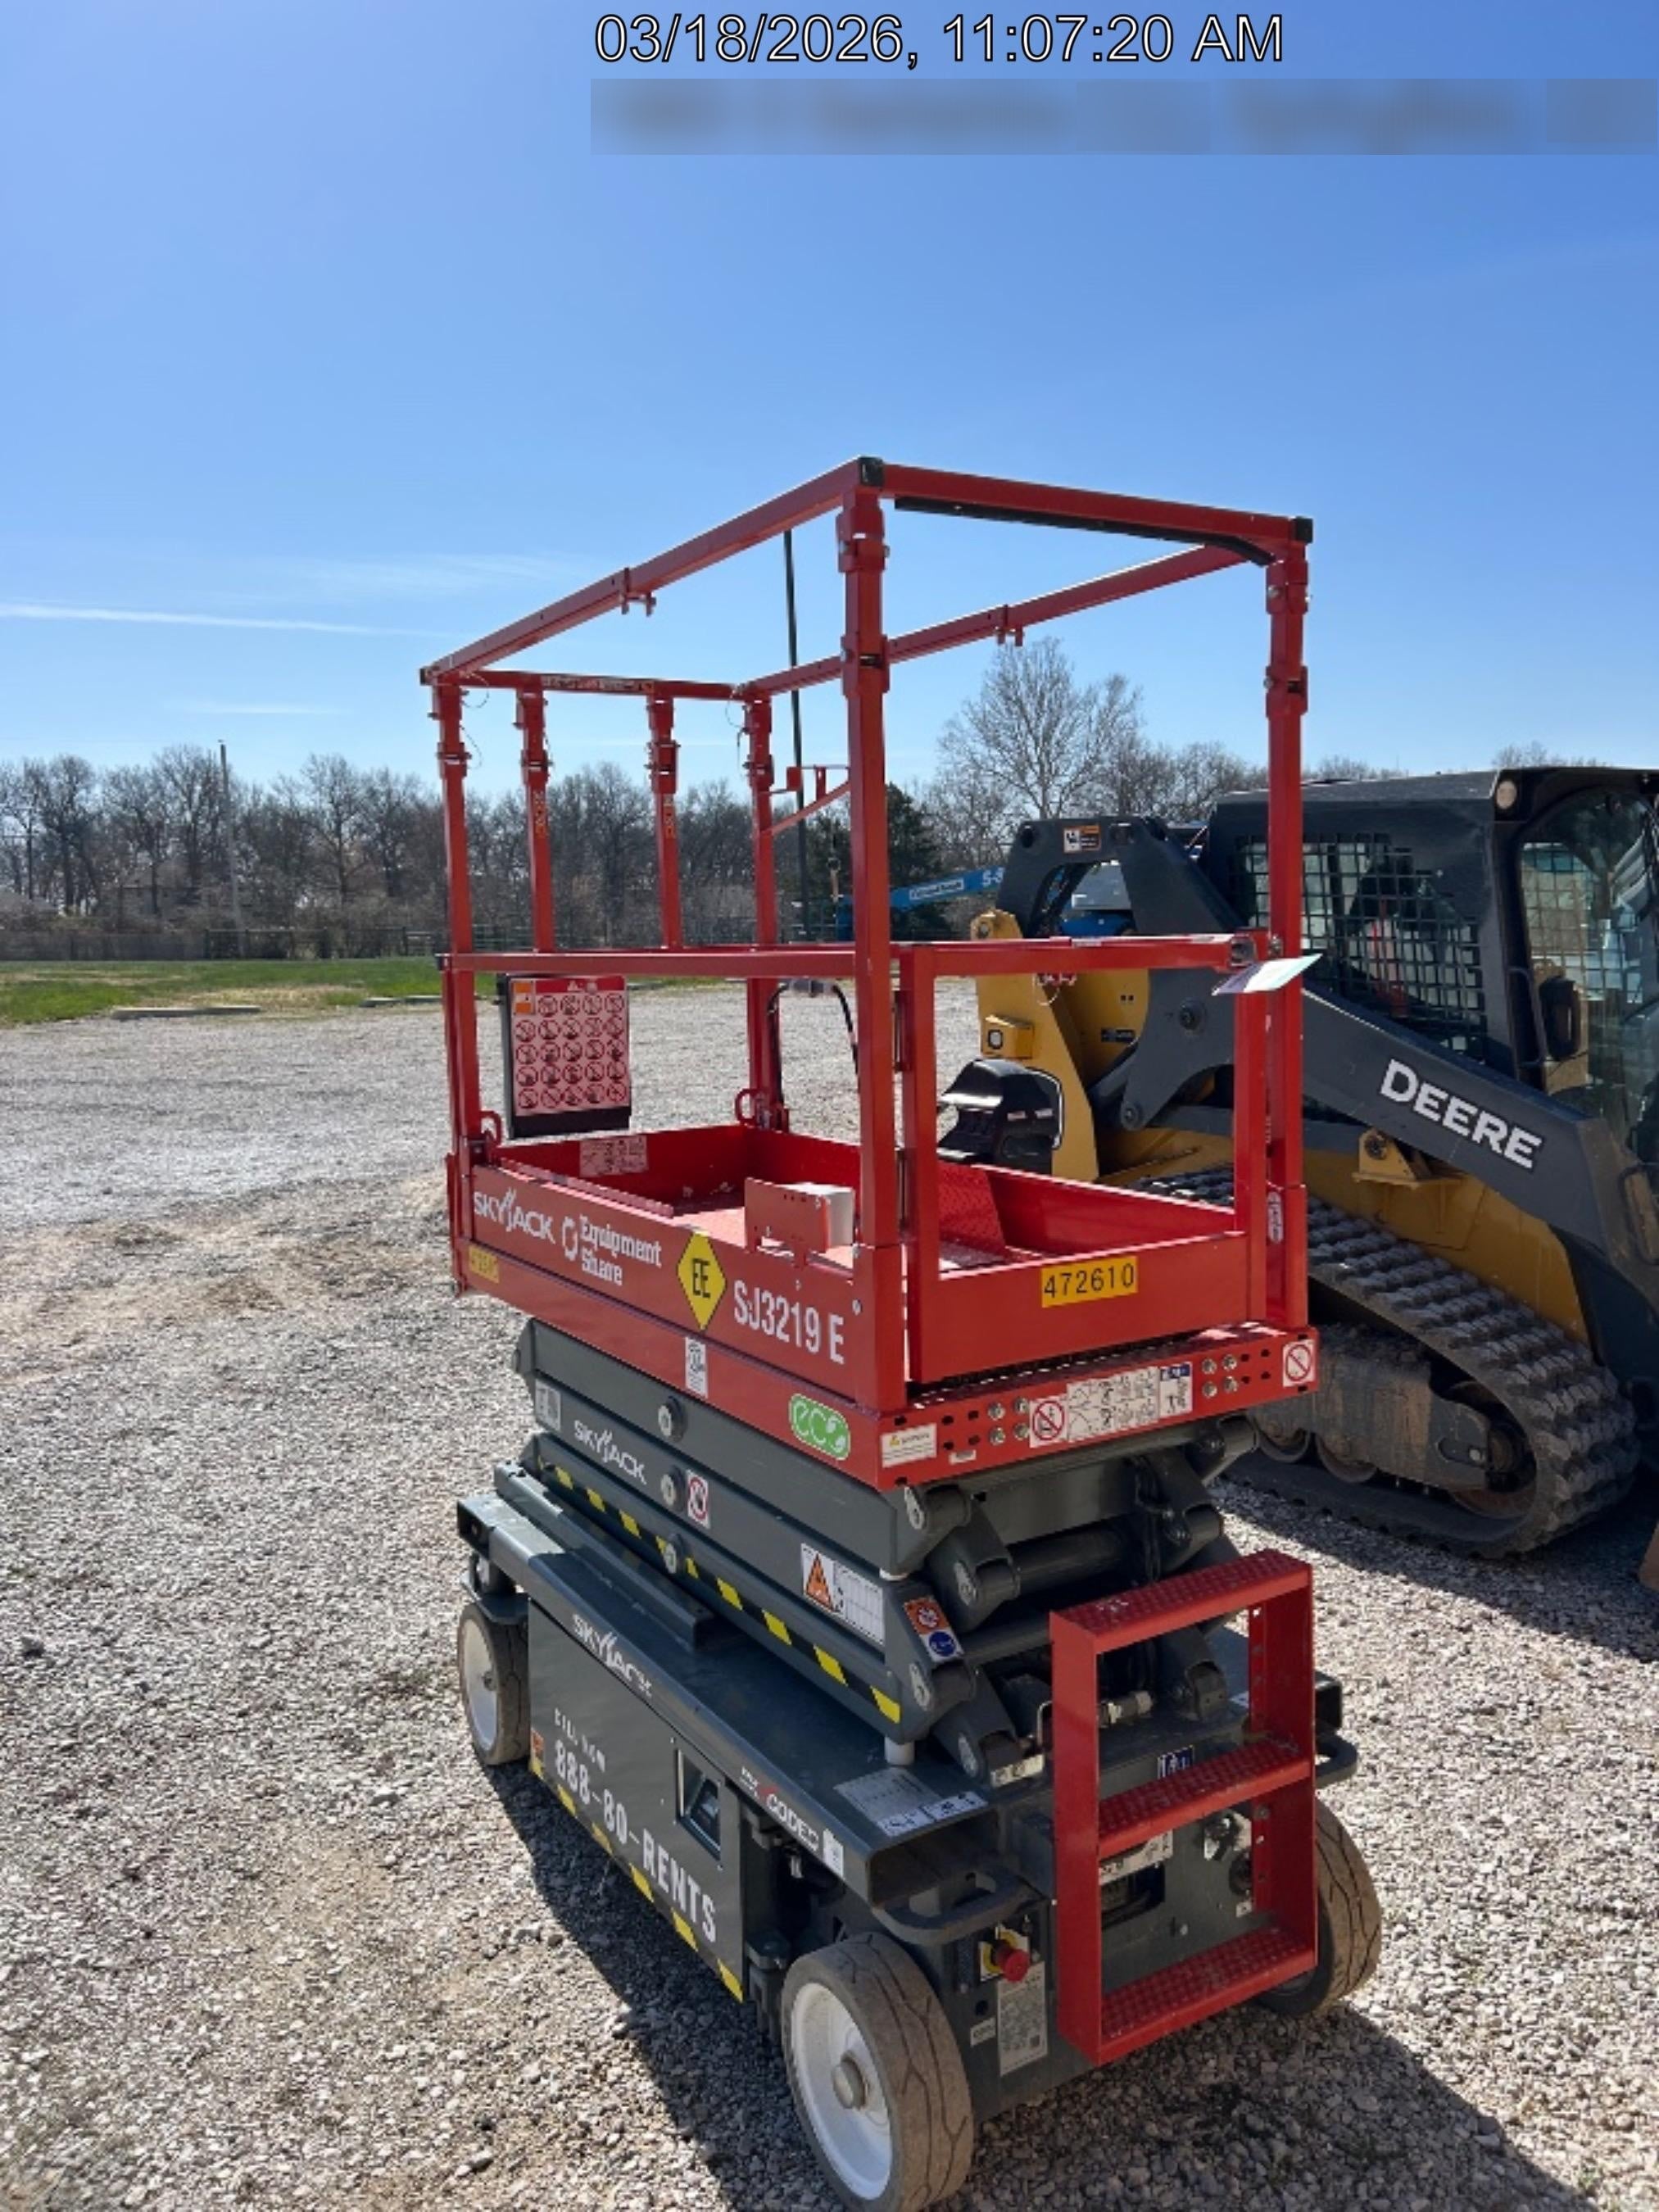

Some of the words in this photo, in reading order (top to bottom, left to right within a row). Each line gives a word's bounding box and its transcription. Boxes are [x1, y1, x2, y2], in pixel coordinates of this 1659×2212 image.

[1380, 1058, 1543, 1169] DEERE
[474, 1187, 555, 1244] SKYJACK
[579, 1214, 662, 1268] Equipment
[582, 1249, 623, 1285] Share
[692, 1258, 710, 1298] EE
[1044, 1262, 1134, 1299] 472610
[734, 1280, 820, 1353] SJ3219
[829, 1313, 845, 1364] E
[574, 1419, 647, 1484] SKYJACK
[555, 1739, 717, 1943] 888-80-RENTS
